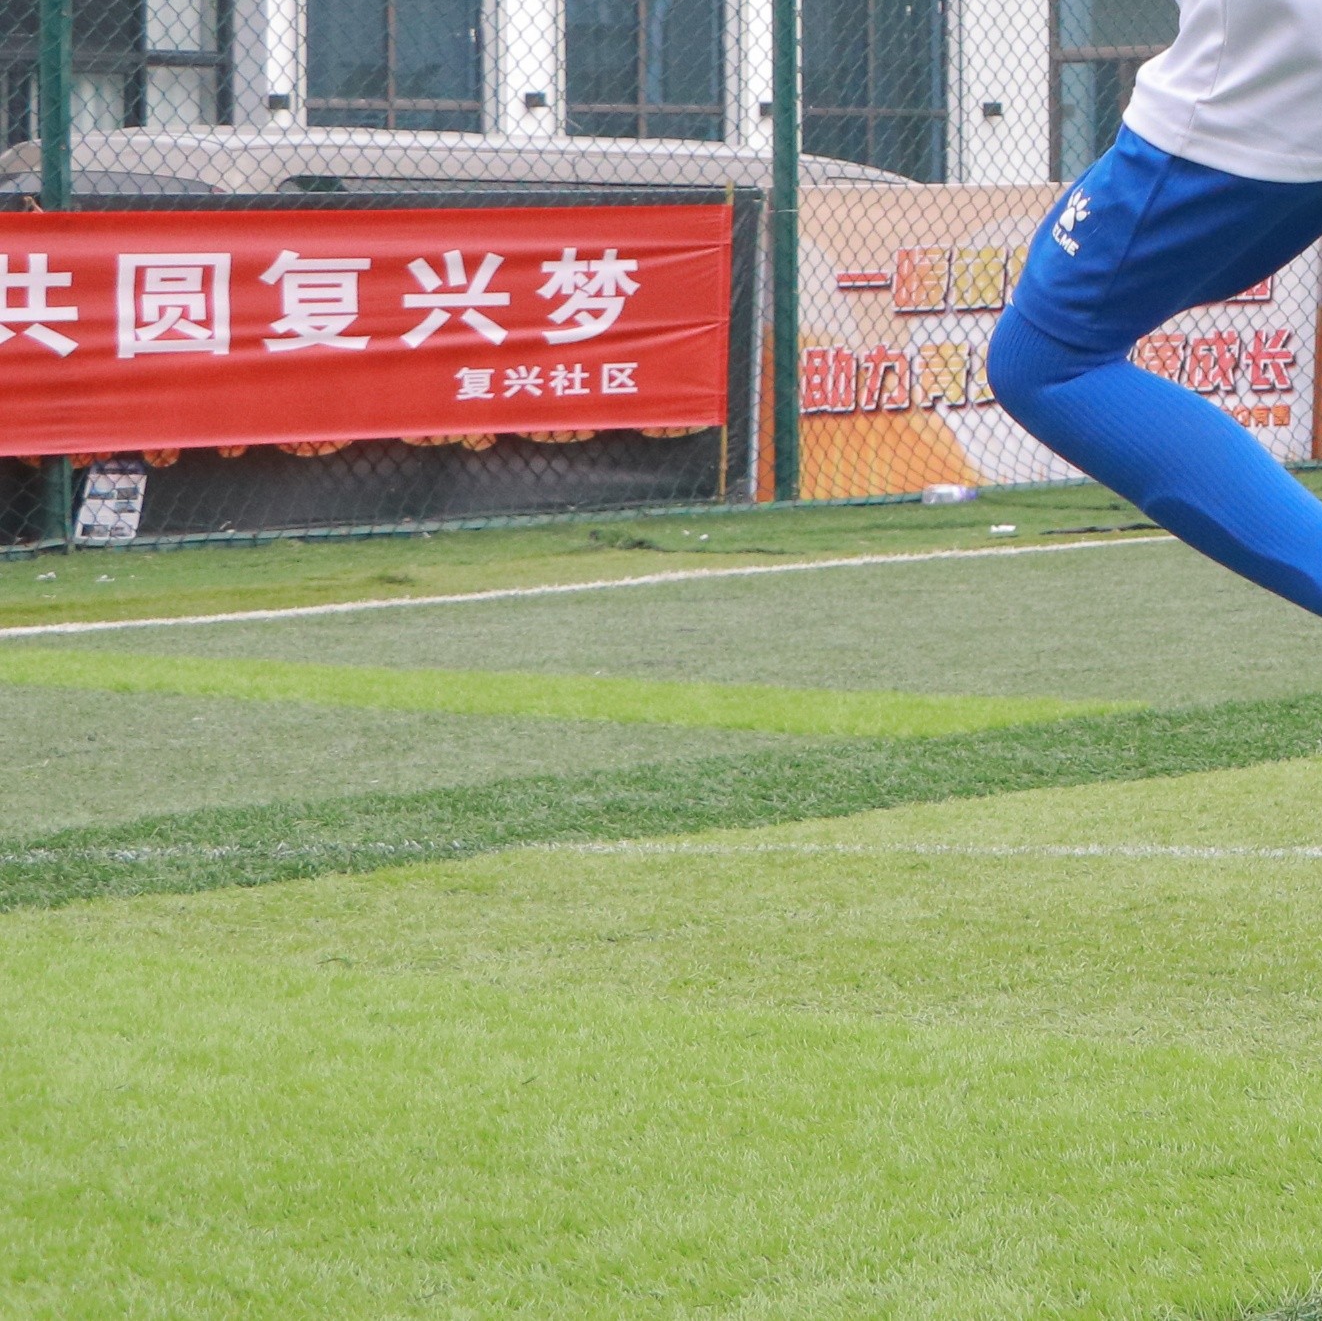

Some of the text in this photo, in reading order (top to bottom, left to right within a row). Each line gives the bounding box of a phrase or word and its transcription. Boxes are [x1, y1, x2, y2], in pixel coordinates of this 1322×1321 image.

[0, 247, 641, 359] 共圆复兴梦
[454, 362, 639, 401] 复兴社区
